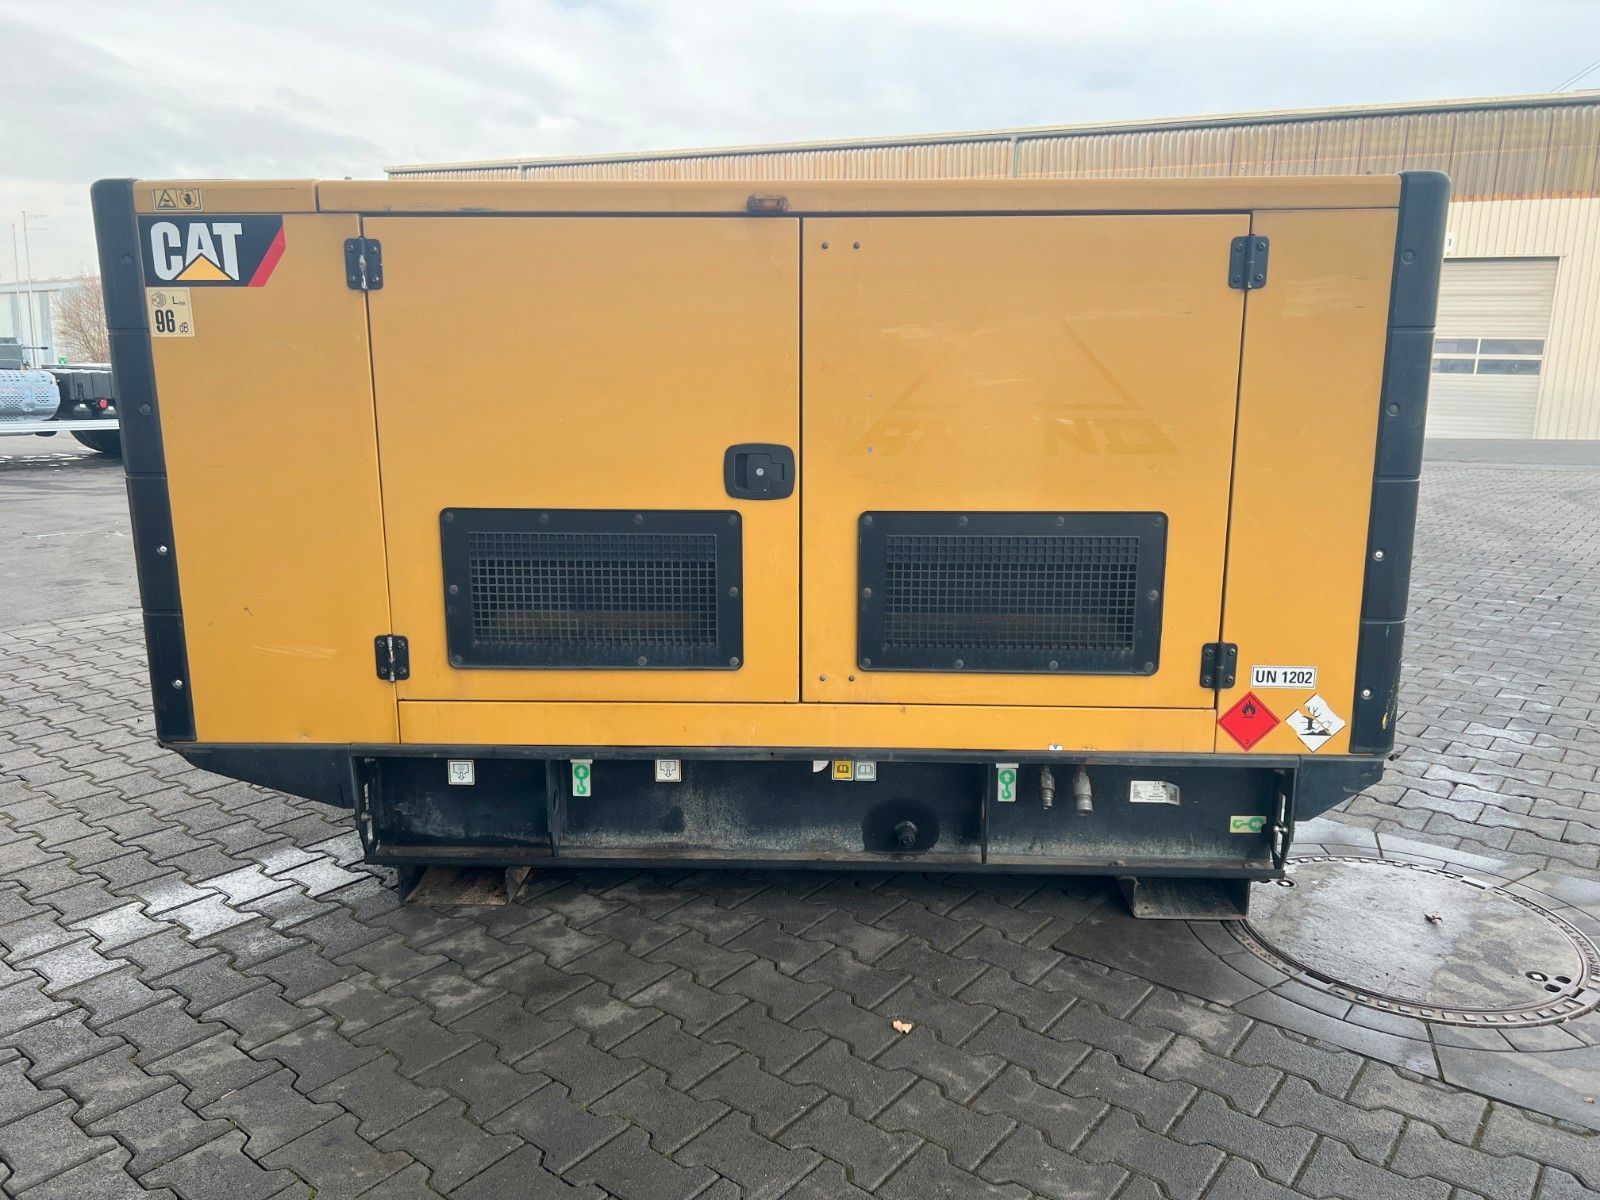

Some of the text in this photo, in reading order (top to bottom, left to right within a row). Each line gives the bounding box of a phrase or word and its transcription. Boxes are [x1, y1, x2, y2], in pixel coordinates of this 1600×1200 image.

[150, 221, 243, 281] CAT
[155, 309, 189, 333] 96 dB
[1255, 670, 1313, 684] UN 1202
